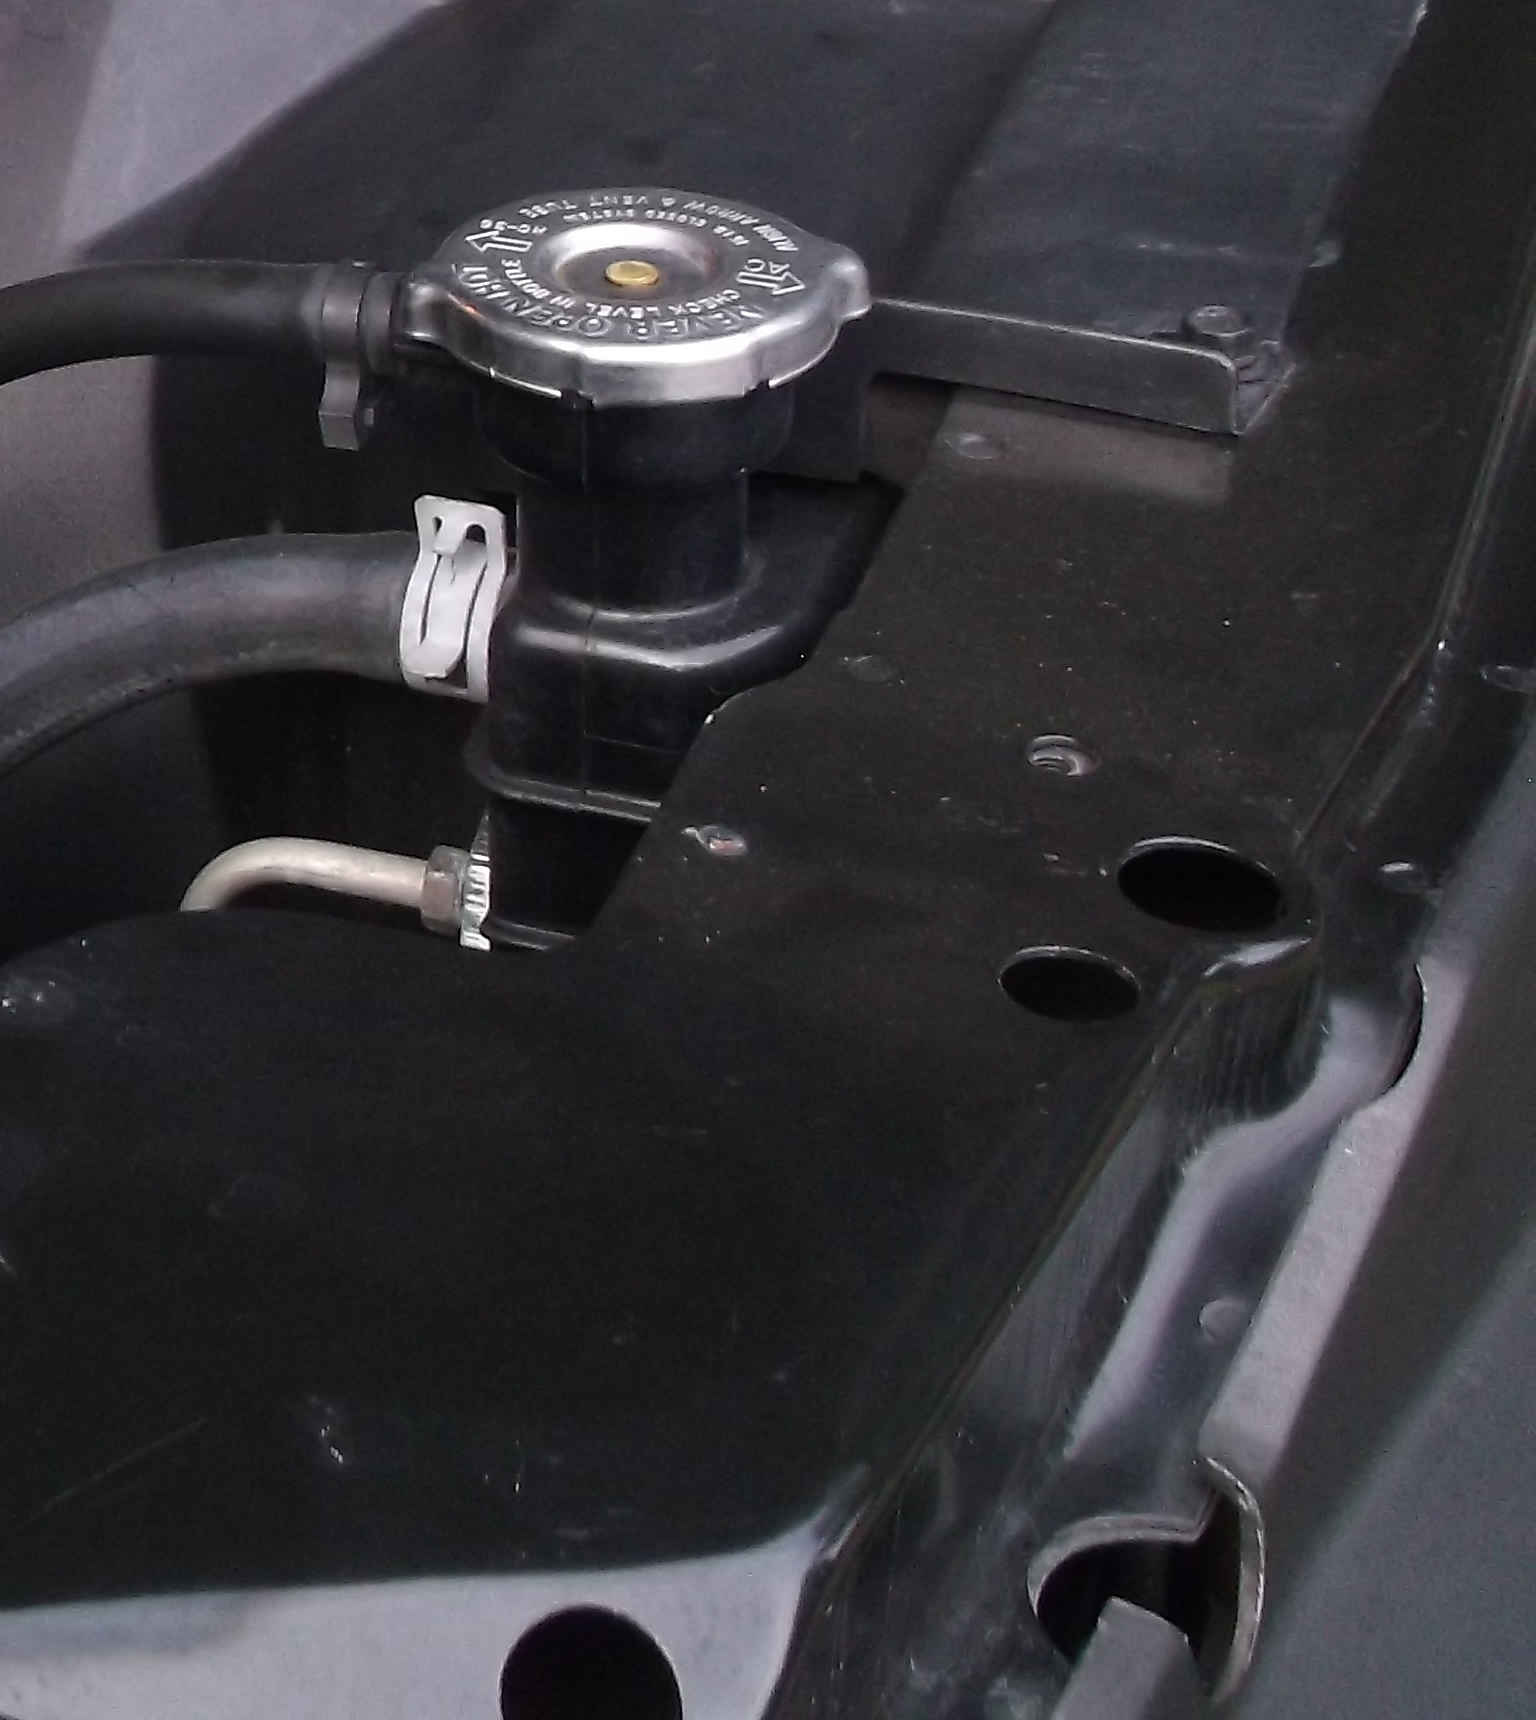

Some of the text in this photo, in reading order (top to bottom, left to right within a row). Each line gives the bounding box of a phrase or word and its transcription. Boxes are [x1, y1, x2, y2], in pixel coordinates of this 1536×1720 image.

[501, 296, 611, 338] OPEN
[584, 301, 662, 320] LEVEL
[667, 288, 741, 316] CHECK
[628, 302, 762, 340] NEVER
